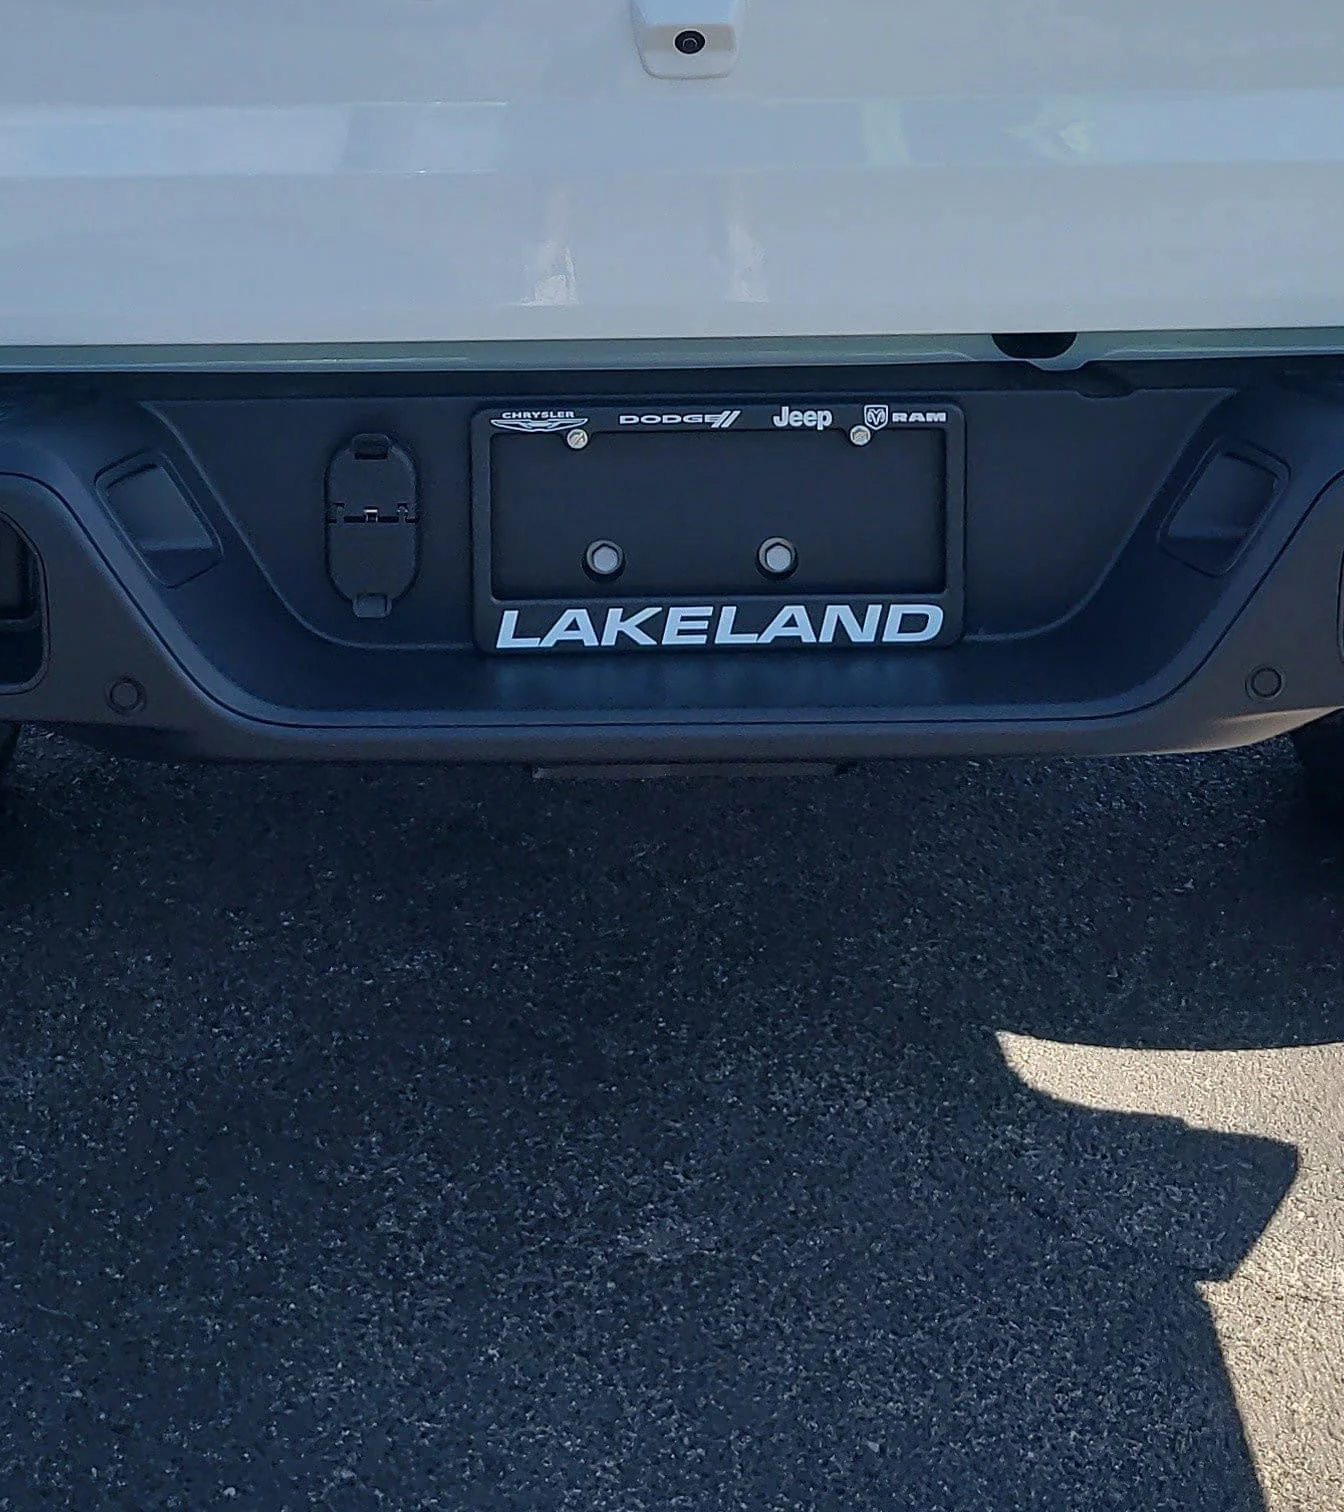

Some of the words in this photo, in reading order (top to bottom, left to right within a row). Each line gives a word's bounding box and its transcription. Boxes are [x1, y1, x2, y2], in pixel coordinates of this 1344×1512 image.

[502, 411, 574, 419] CHRYSLER
[619, 414, 720, 424] DODGE
[773, 406, 833, 430] Jeep
[892, 412, 946, 422] RAM
[496, 604, 944, 648] LAKELAND
